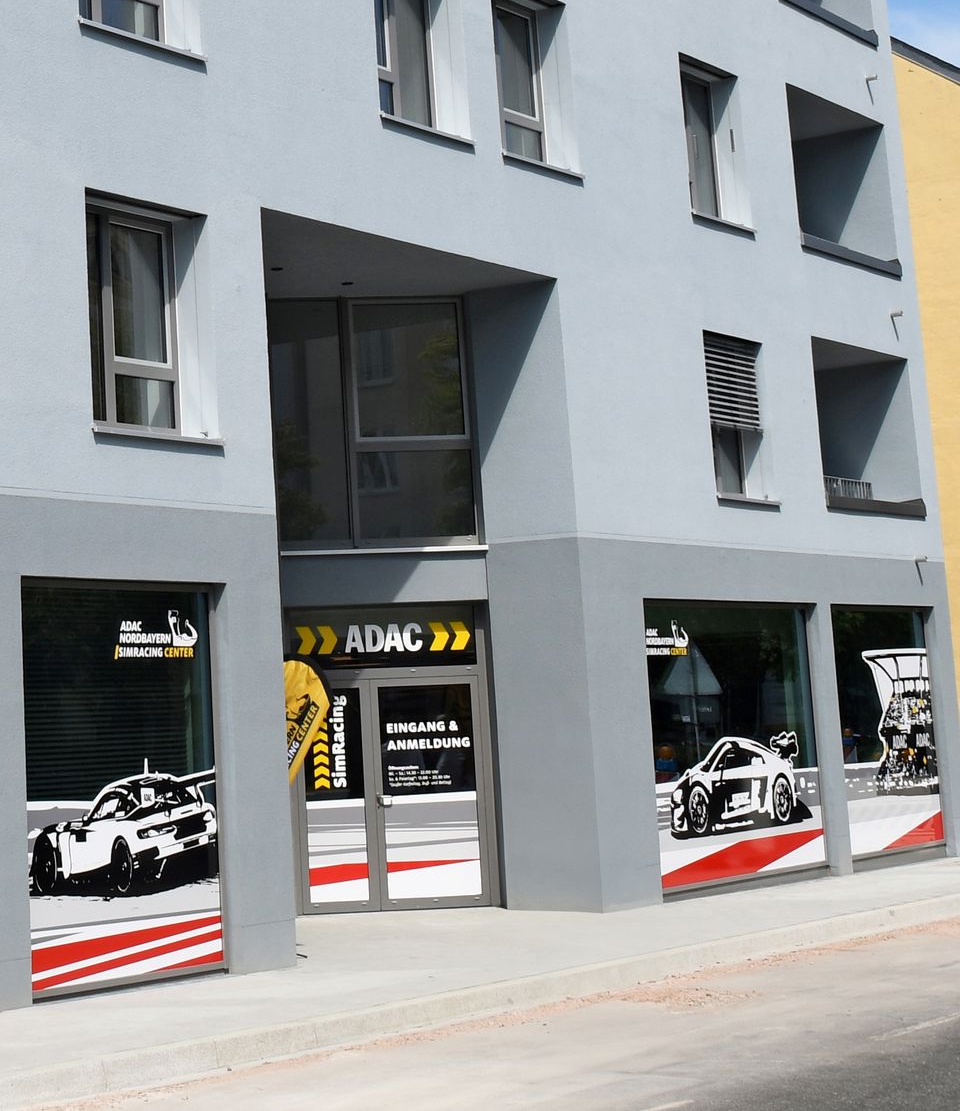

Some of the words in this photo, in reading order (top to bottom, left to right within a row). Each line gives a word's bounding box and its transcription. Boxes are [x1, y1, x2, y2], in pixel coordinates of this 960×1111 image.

[120, 621, 142, 632] ADAC
[119, 633, 171, 644] NORDBAYERN
[345, 623, 423, 653] ADAC
[119, 647, 163, 658] SIMRACING
[164, 647, 194, 658] CENTER
[296, 705, 318, 741] CENTER
[386, 721, 446, 734] EINGANG
[448, 720, 459, 732] &
[387, 736, 471, 751] ANMELDUNG
[892, 735, 908, 750] ADAC
[915, 733, 931, 748] ADAC
